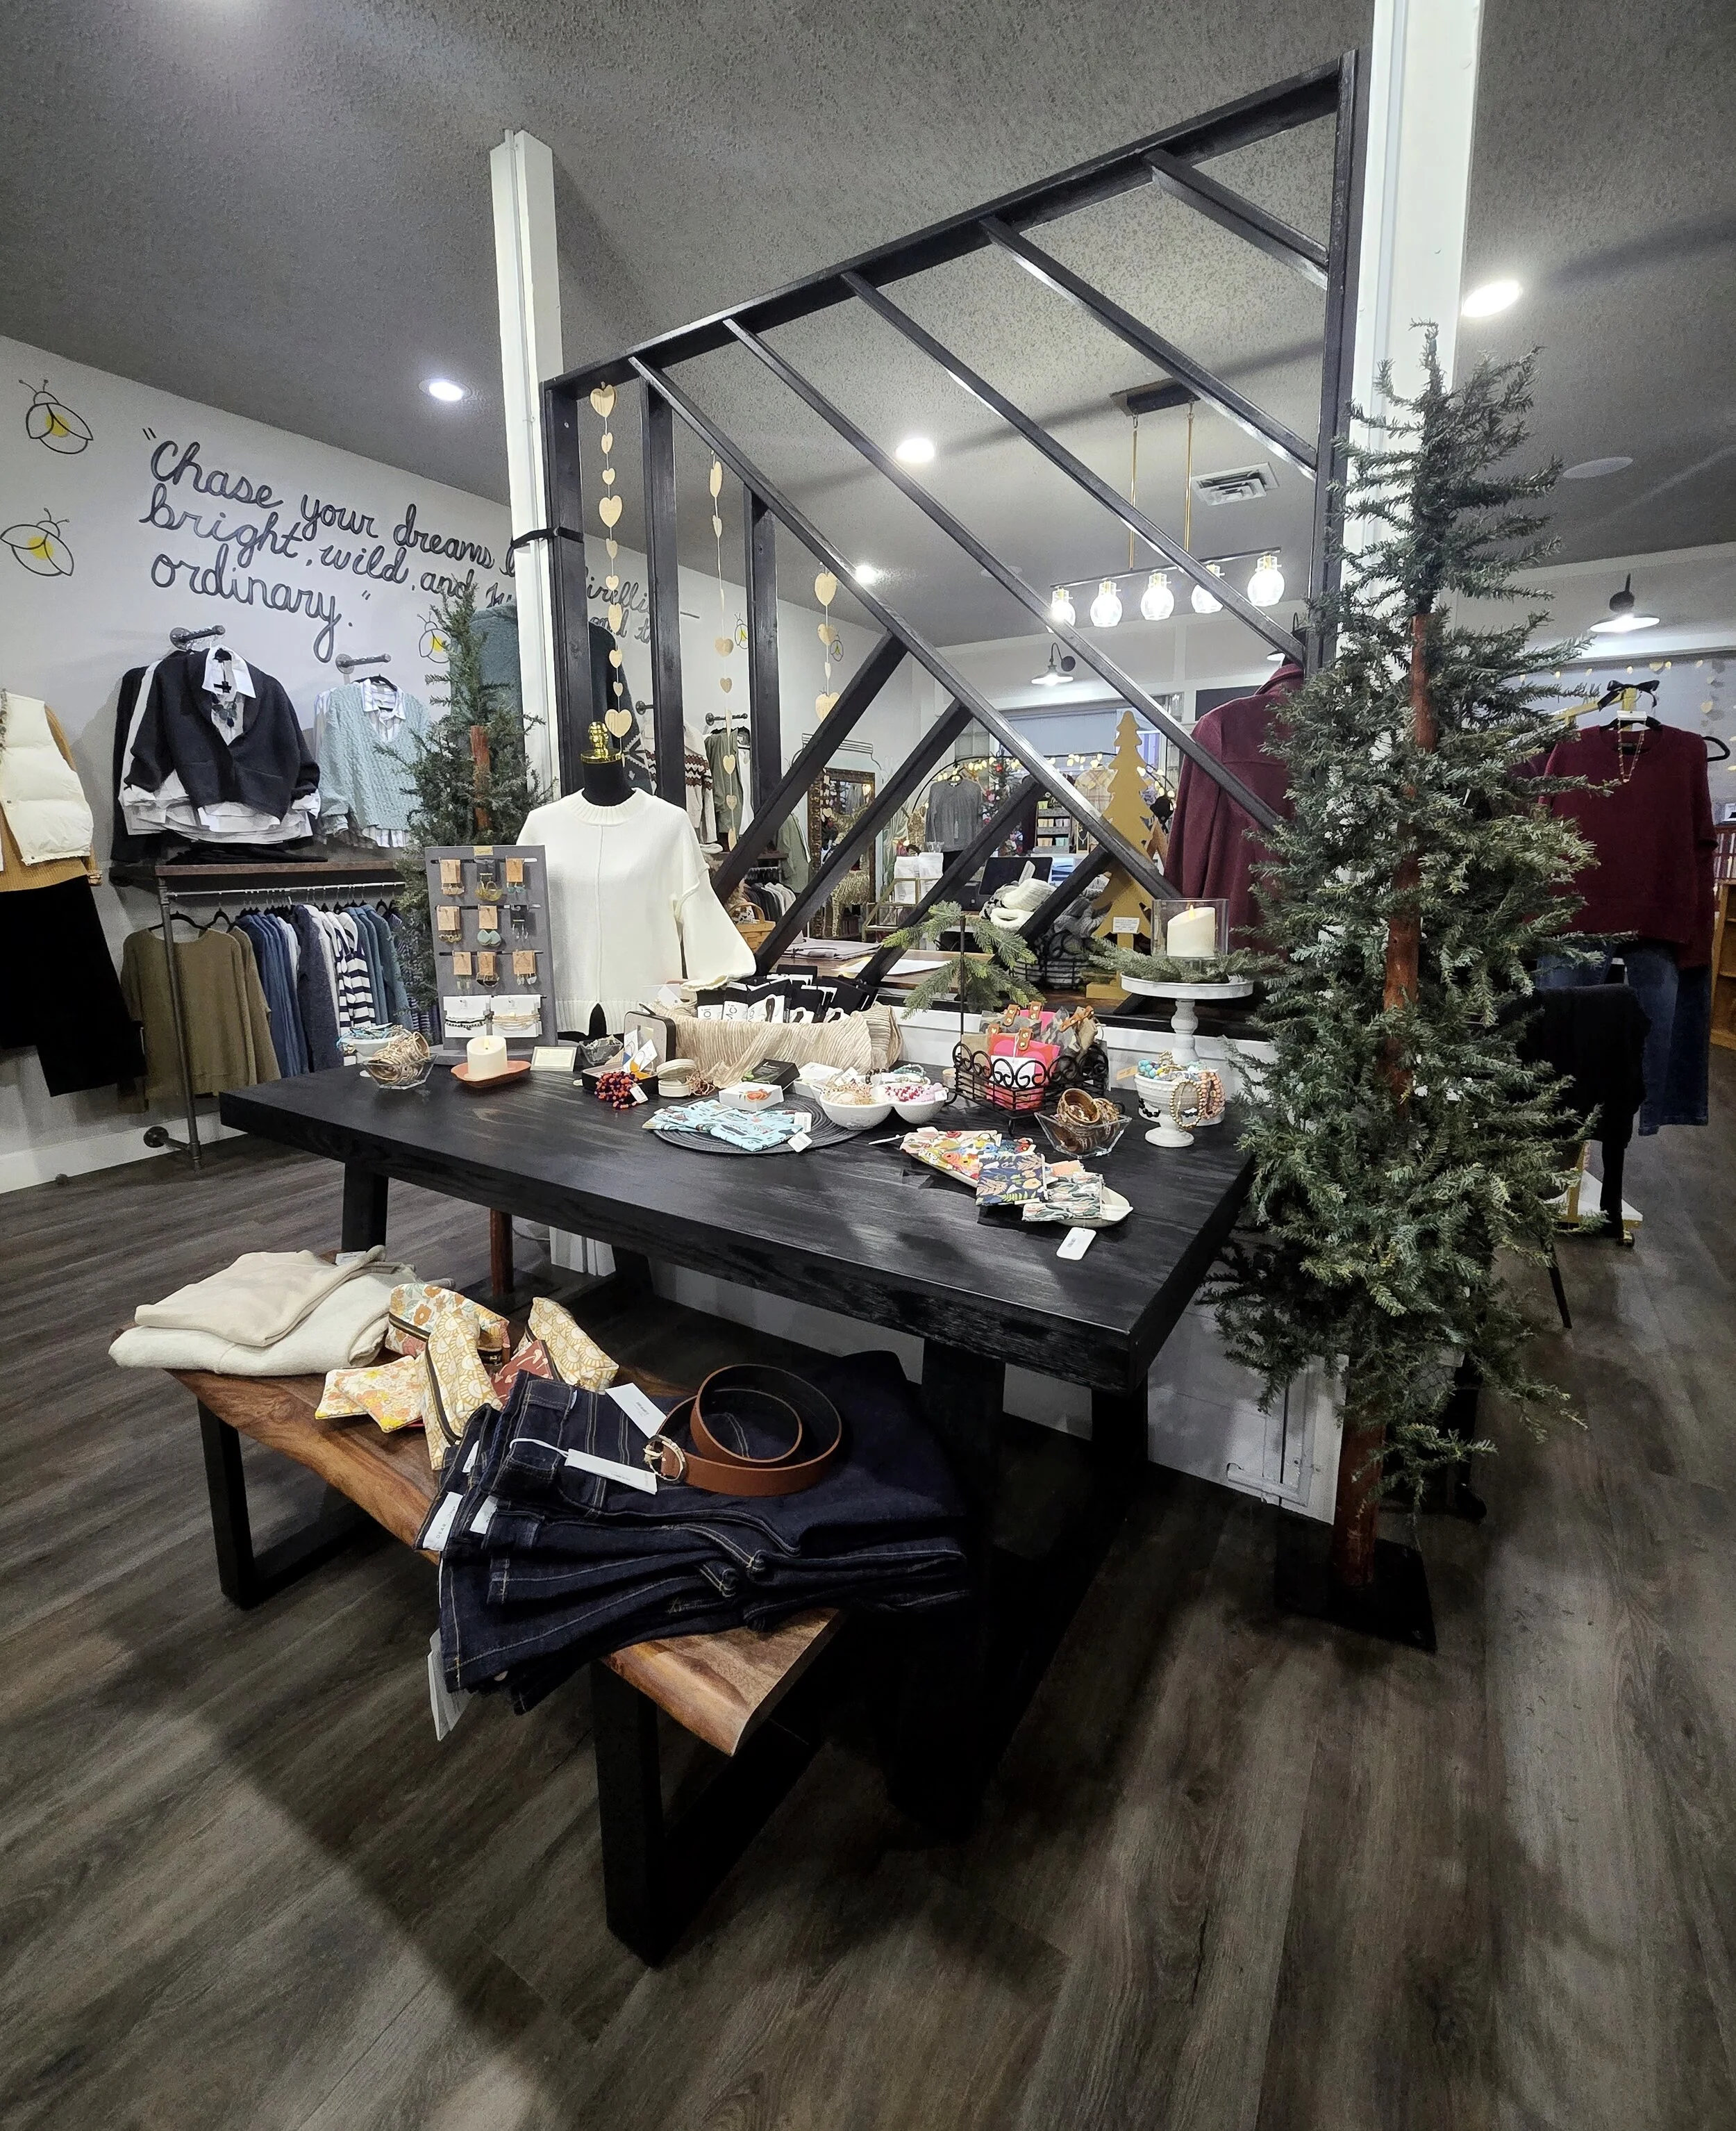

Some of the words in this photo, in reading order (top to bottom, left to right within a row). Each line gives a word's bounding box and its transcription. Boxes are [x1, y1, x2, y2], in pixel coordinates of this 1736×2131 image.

[139, 483, 312, 568] bright,
[319, 545, 416, 591] wild,
[420, 568, 475, 599] and
[301, 494, 379, 541] your
[393, 504, 495, 569] dreams
